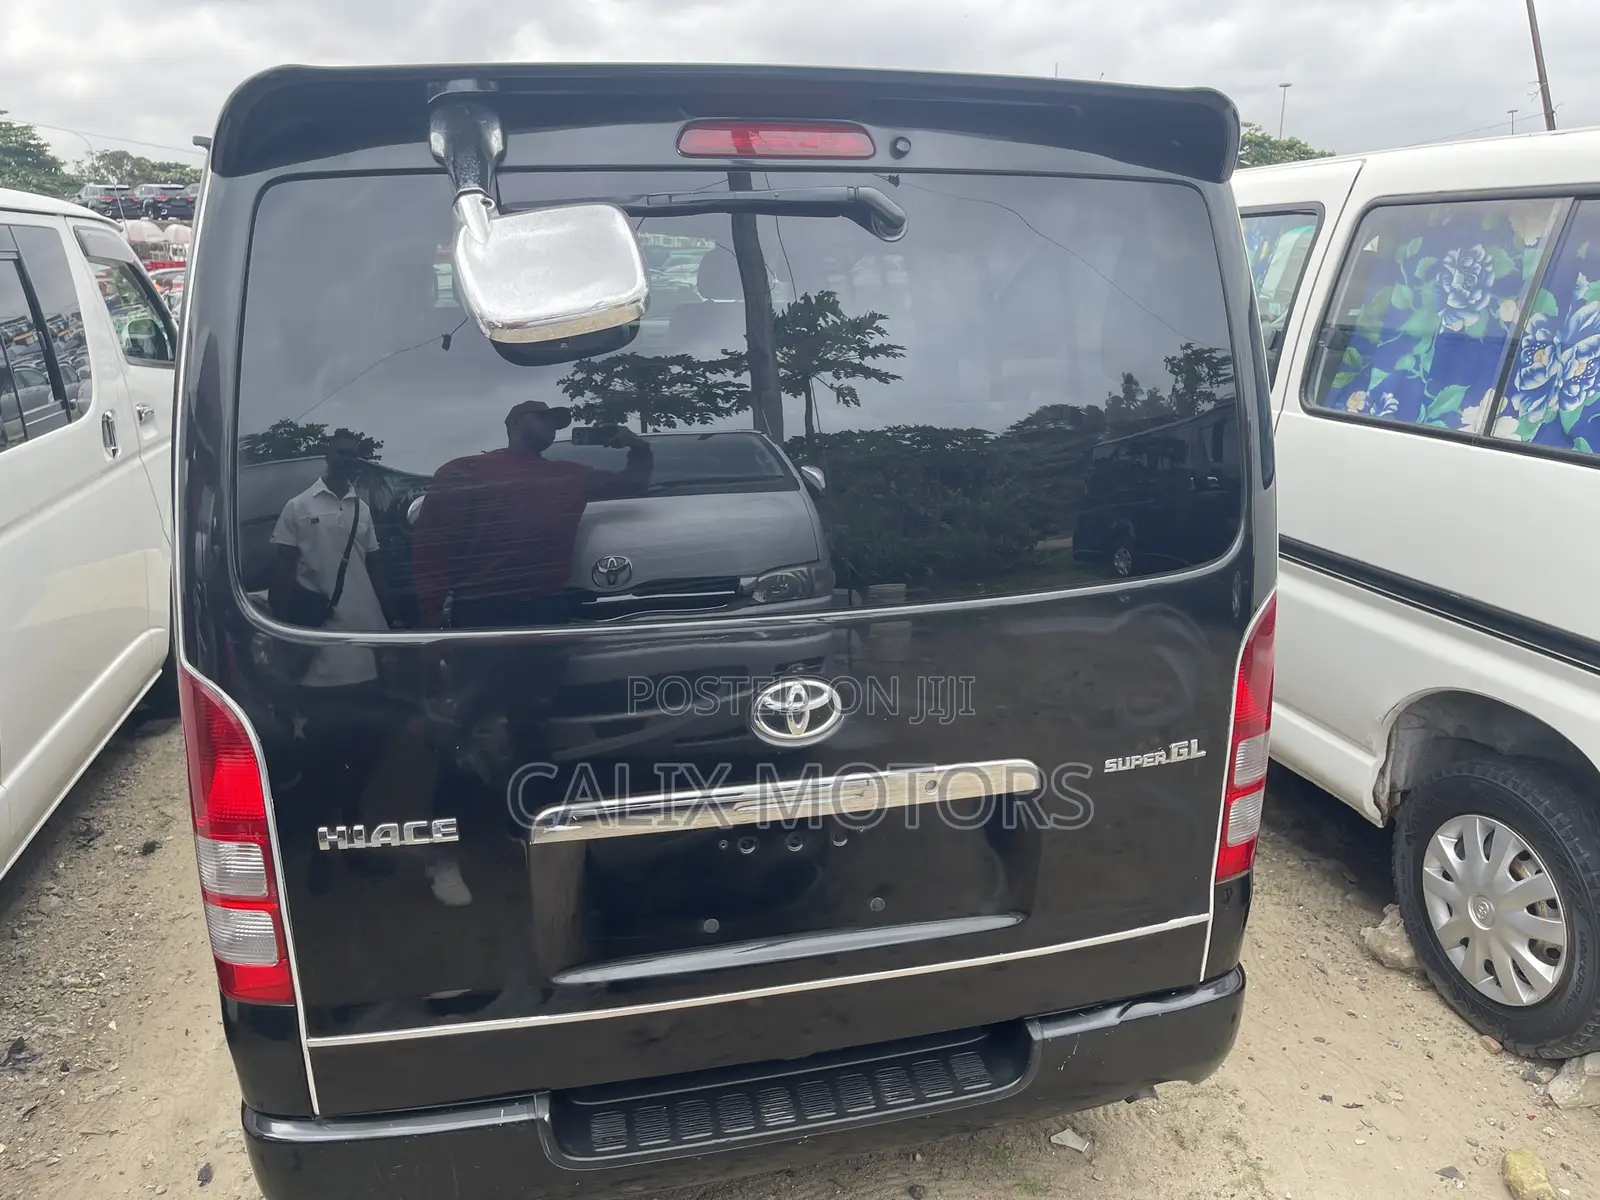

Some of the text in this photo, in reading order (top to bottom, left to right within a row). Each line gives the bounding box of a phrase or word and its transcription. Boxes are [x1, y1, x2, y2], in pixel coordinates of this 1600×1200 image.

[1103, 739, 1207, 773] SUPER GL
[317, 817, 460, 851] HIACE
